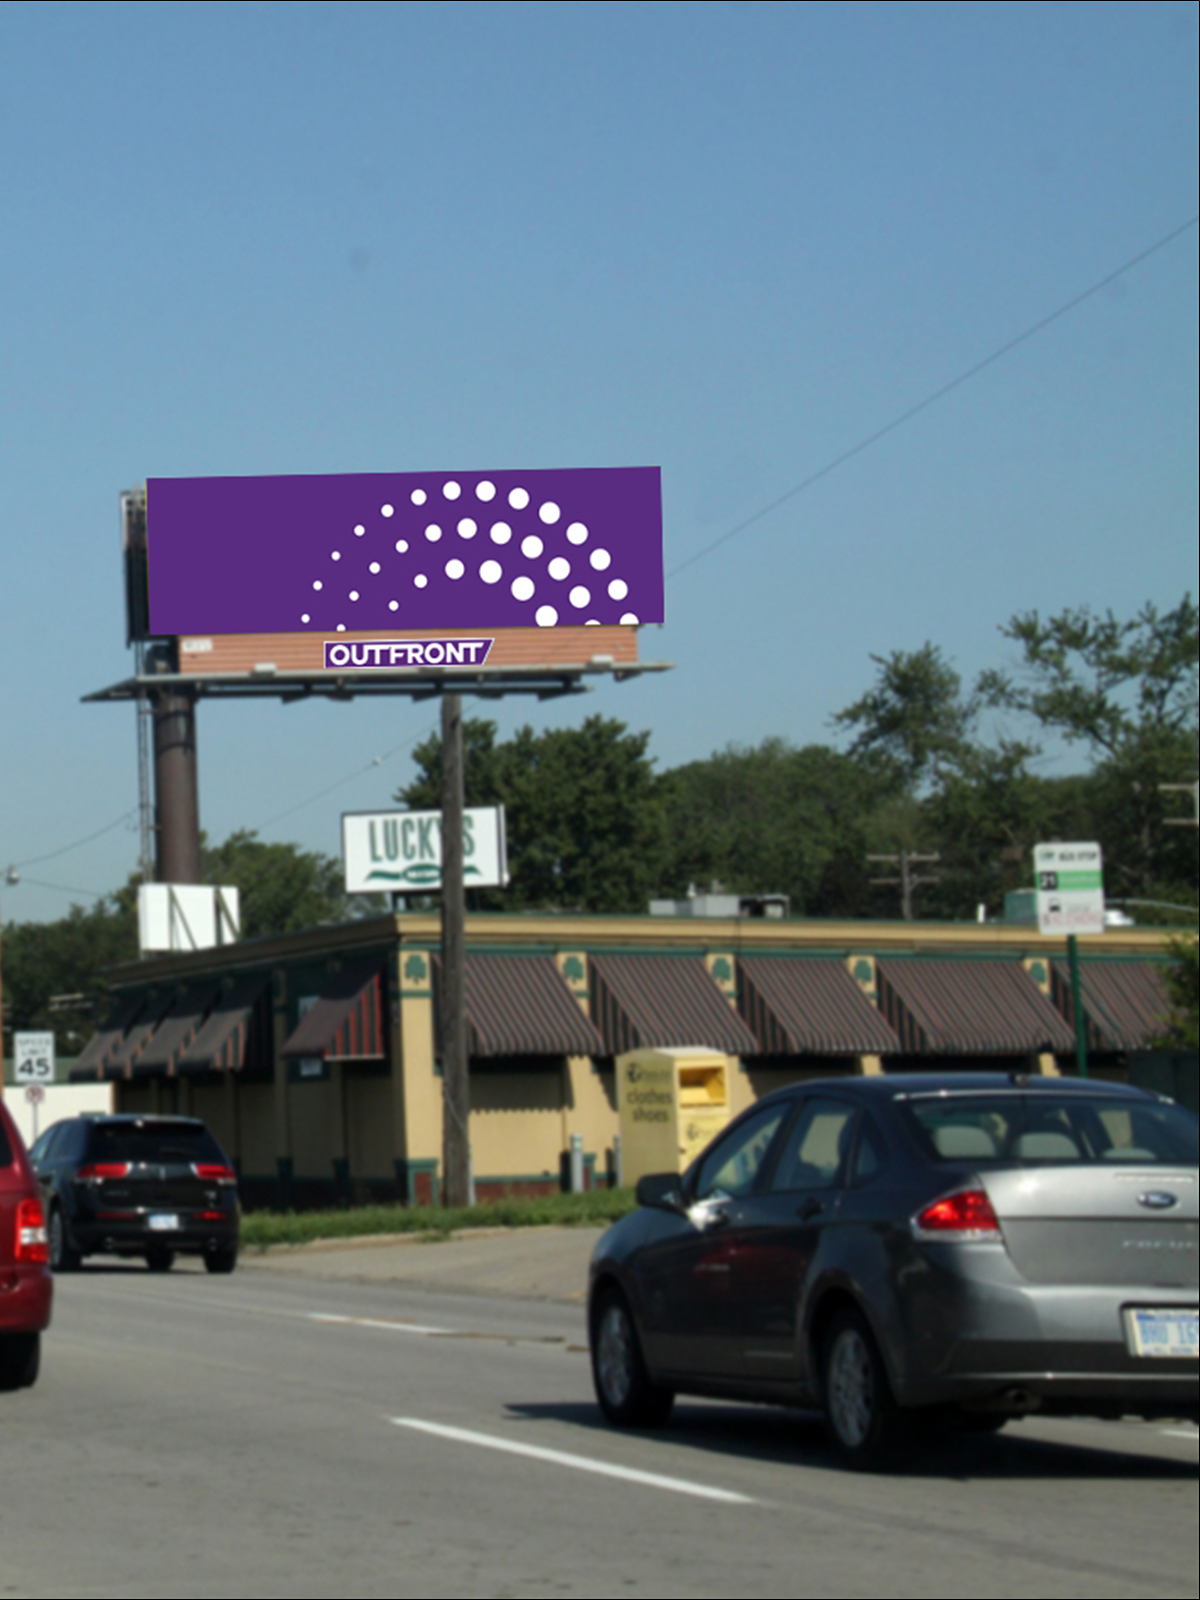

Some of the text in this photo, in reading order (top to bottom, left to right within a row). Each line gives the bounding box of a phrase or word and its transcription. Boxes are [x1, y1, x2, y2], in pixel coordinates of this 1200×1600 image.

[329, 642, 485, 666] OUTFRONT
[369, 814, 475, 862] LUCKS
[19, 1058, 50, 1076] 45
[626, 1088, 673, 1104] clothes
[633, 1106, 668, 1122] shoes
